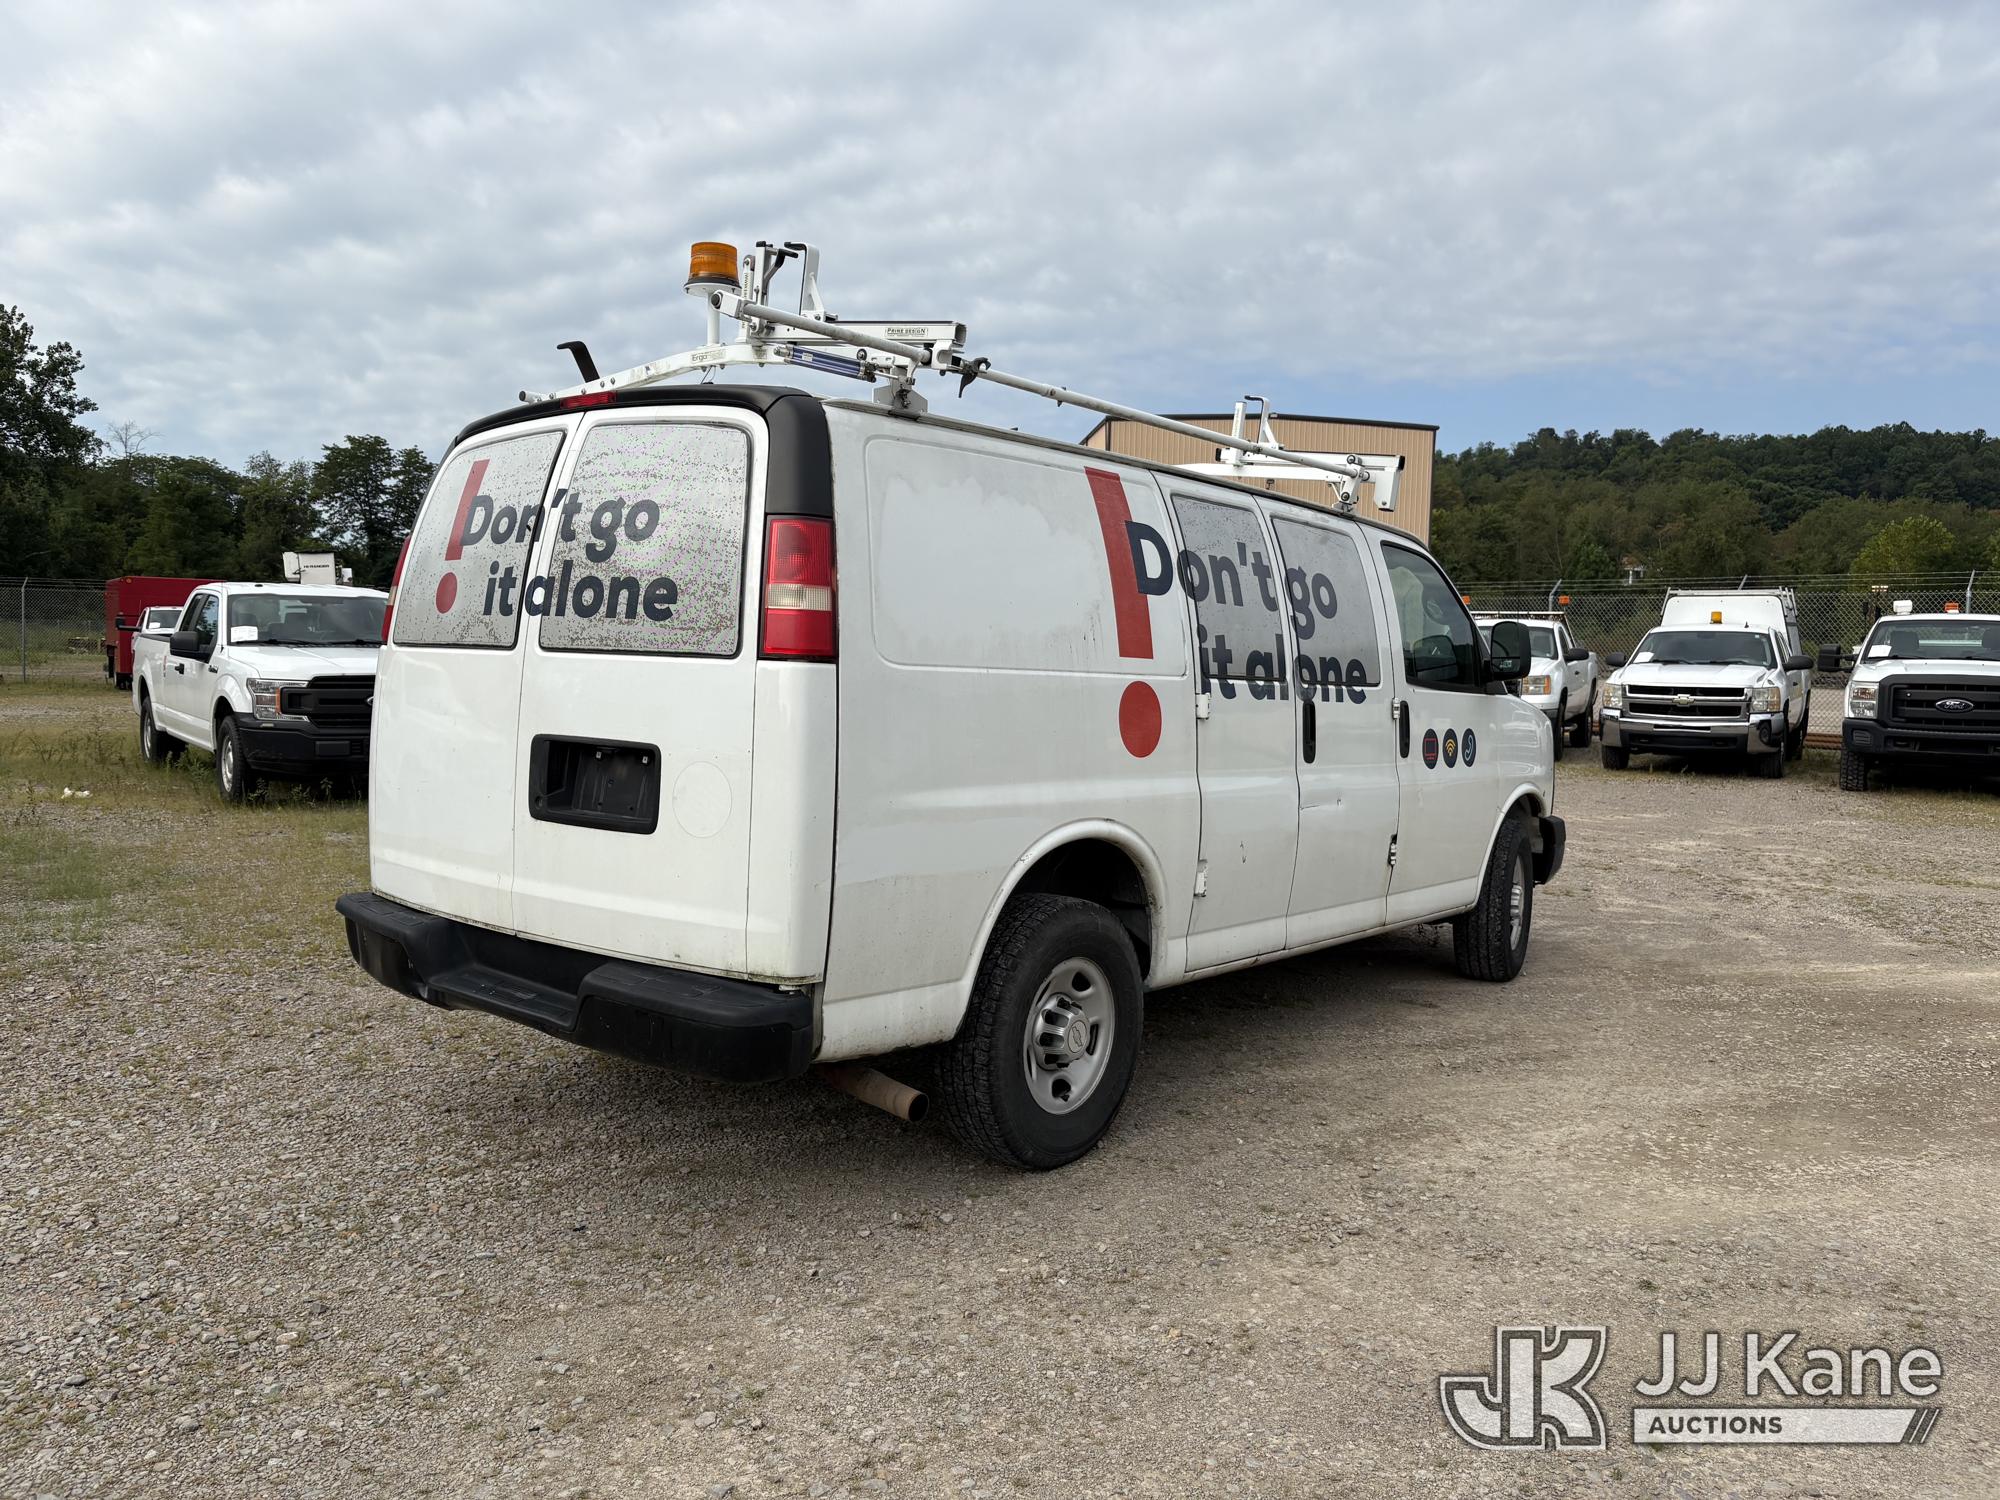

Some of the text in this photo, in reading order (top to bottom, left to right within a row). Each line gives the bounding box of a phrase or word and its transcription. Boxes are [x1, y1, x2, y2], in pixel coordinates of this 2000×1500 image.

[461, 488, 661, 563] Don't go
[483, 559, 678, 621] it alone
[1125, 520, 1338, 640] Don't go
[1197, 623, 1367, 704] it alone
